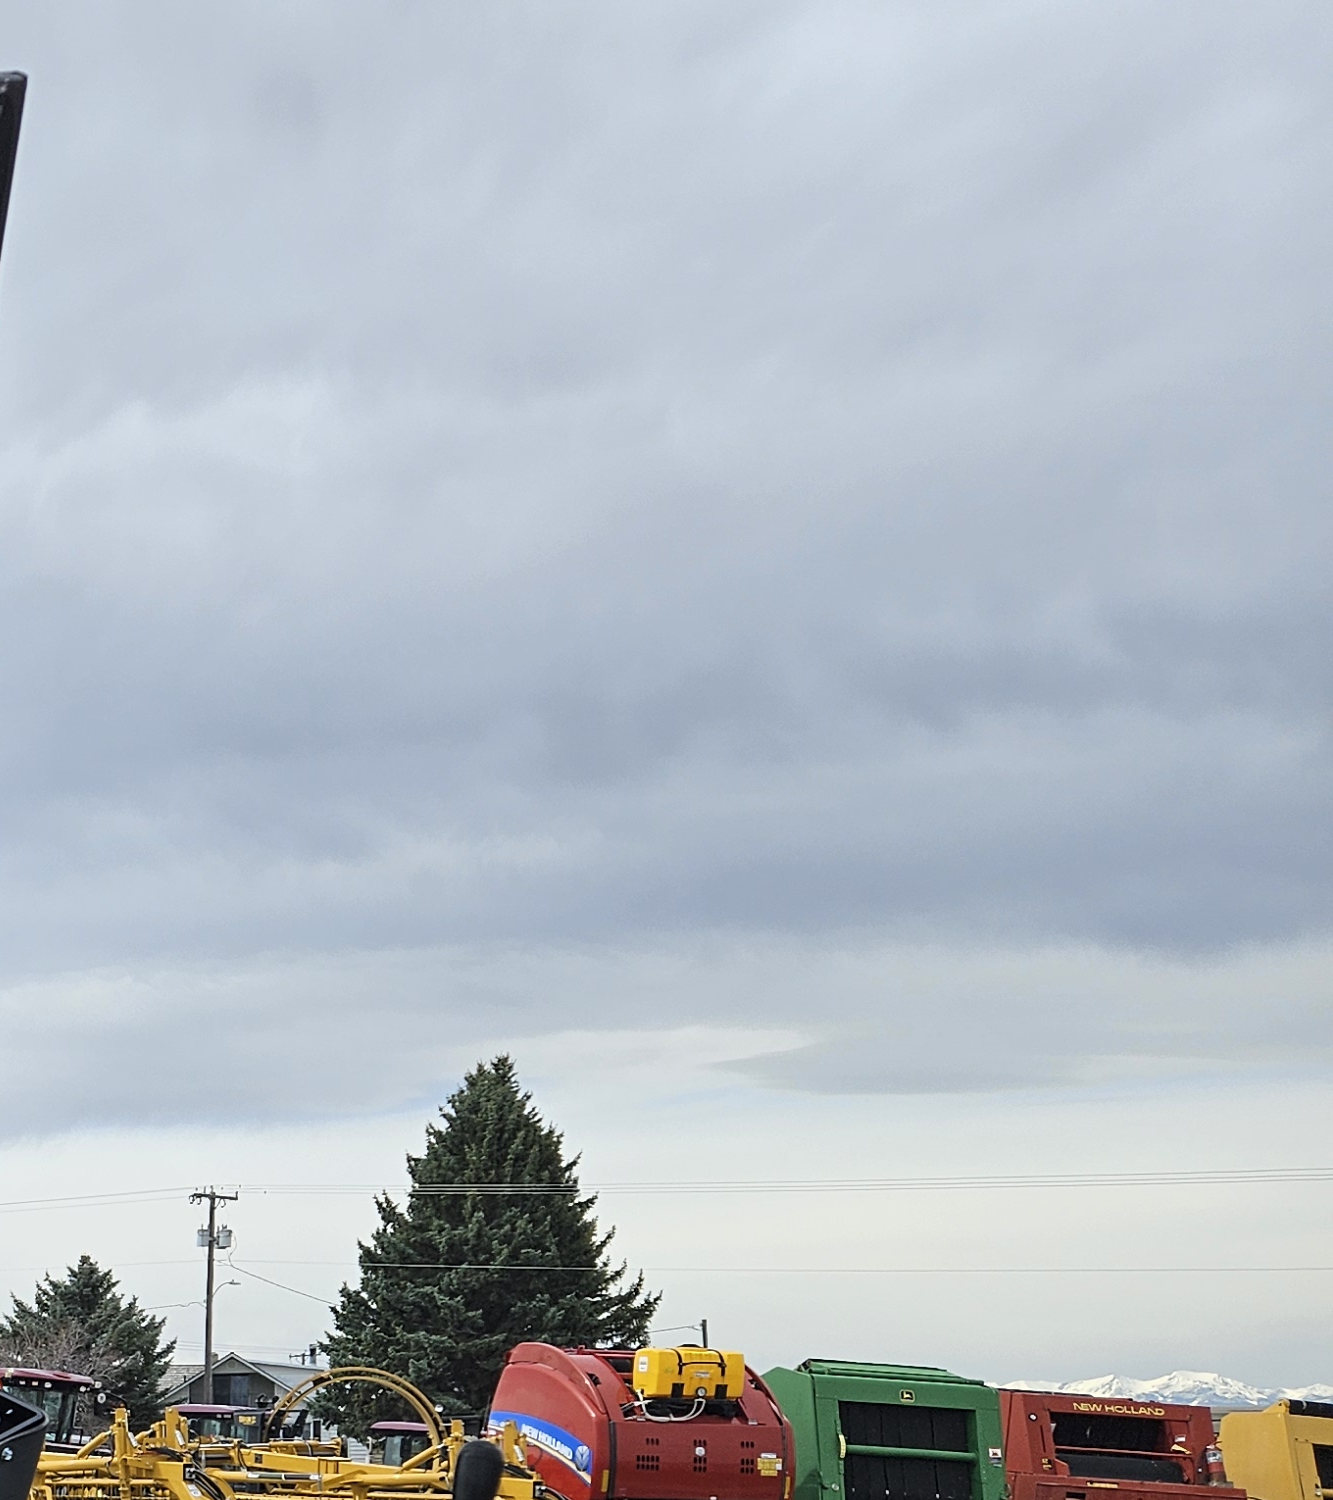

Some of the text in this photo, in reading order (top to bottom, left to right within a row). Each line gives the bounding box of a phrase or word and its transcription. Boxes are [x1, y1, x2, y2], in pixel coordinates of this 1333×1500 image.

[1073, 1402, 1165, 1416] NEW HOLLAND
[538, 1430, 572, 1460] HOLLAND
